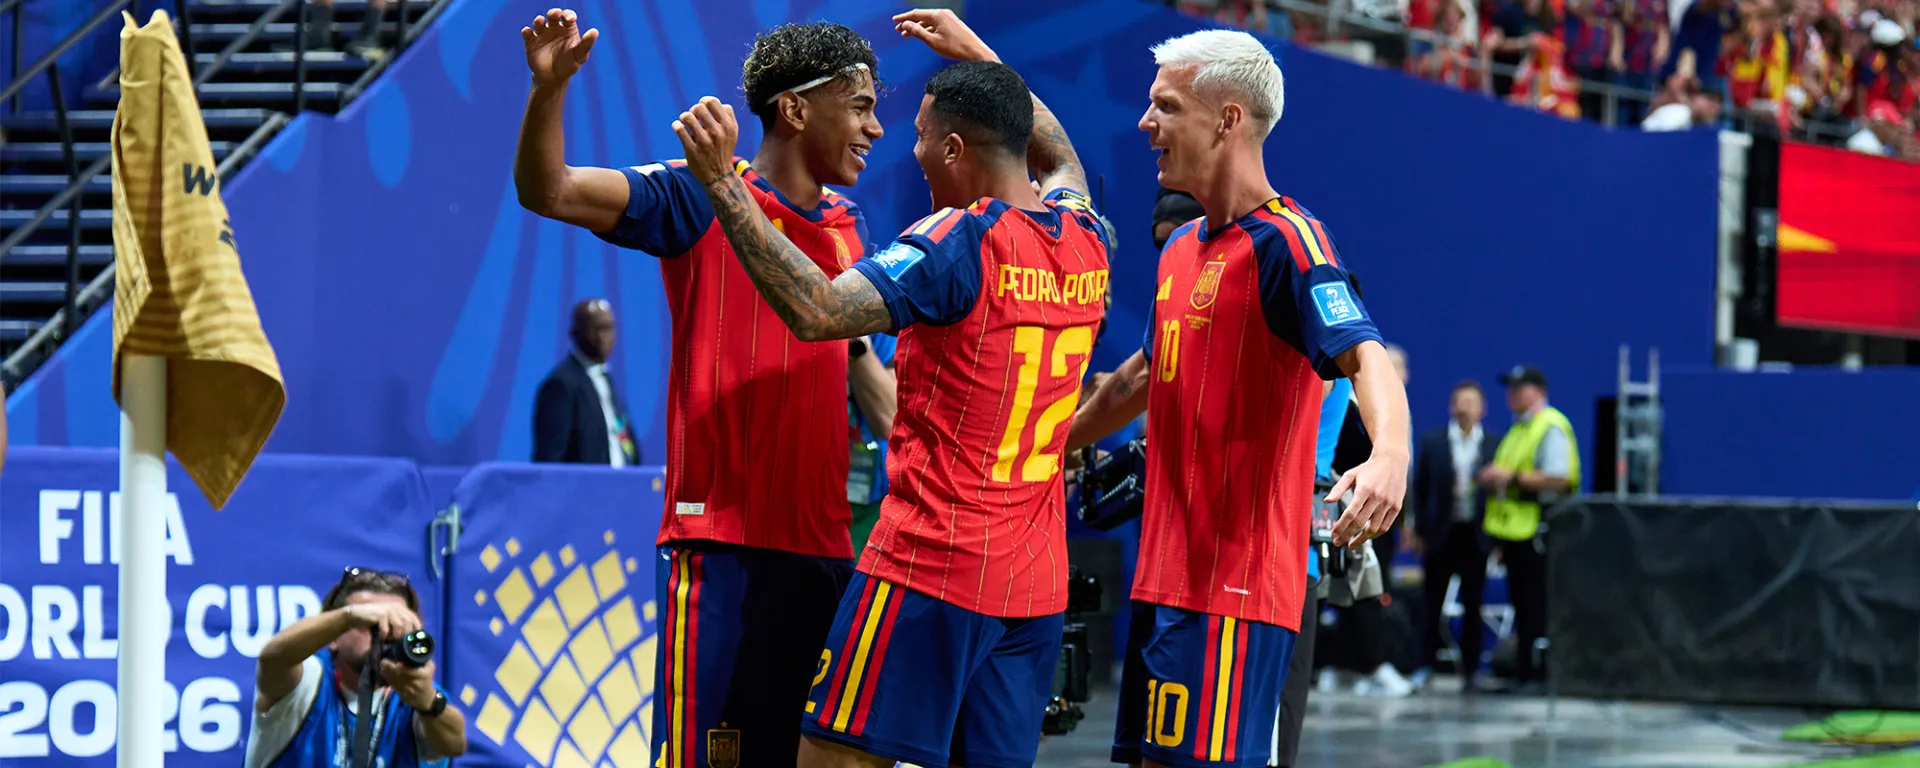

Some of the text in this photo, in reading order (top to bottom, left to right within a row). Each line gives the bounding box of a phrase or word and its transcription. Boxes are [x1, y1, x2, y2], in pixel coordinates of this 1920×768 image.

[997, 264, 1061, 303] PEDRO
[1156, 319, 1180, 383] 10
[991, 326, 1092, 482] 12
[39, 489, 194, 565] FIA
[0, 583, 322, 661] ORL CUP
[0, 677, 241, 758] 206
[1145, 679, 1189, 747] 10
